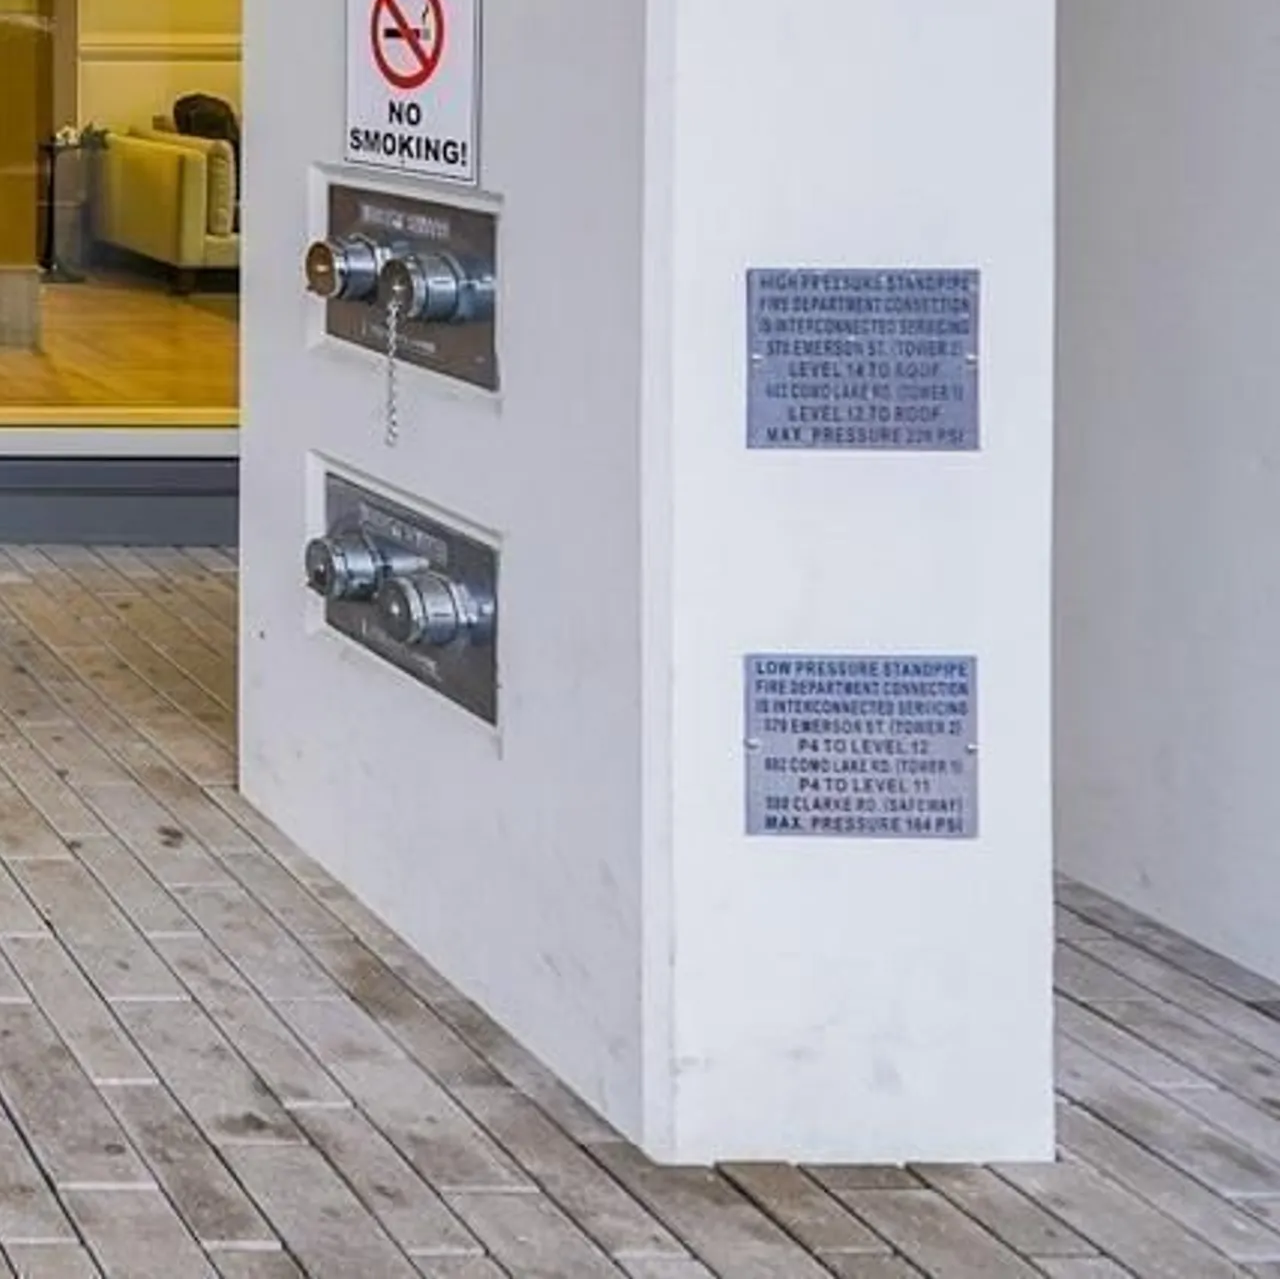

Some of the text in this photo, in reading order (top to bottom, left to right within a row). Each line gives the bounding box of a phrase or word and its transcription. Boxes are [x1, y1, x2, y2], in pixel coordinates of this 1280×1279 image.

[388, 100, 421, 126] NO
[350, 127, 467, 166] SMOKING!
[755, 661, 791, 677] LOW
[795, 661, 879, 677] PRESSURE
[824, 738, 847, 755] TO
[851, 738, 909, 755] LEVEL
[824, 777, 848, 794] TO
[852, 777, 909, 794] LEVEL
